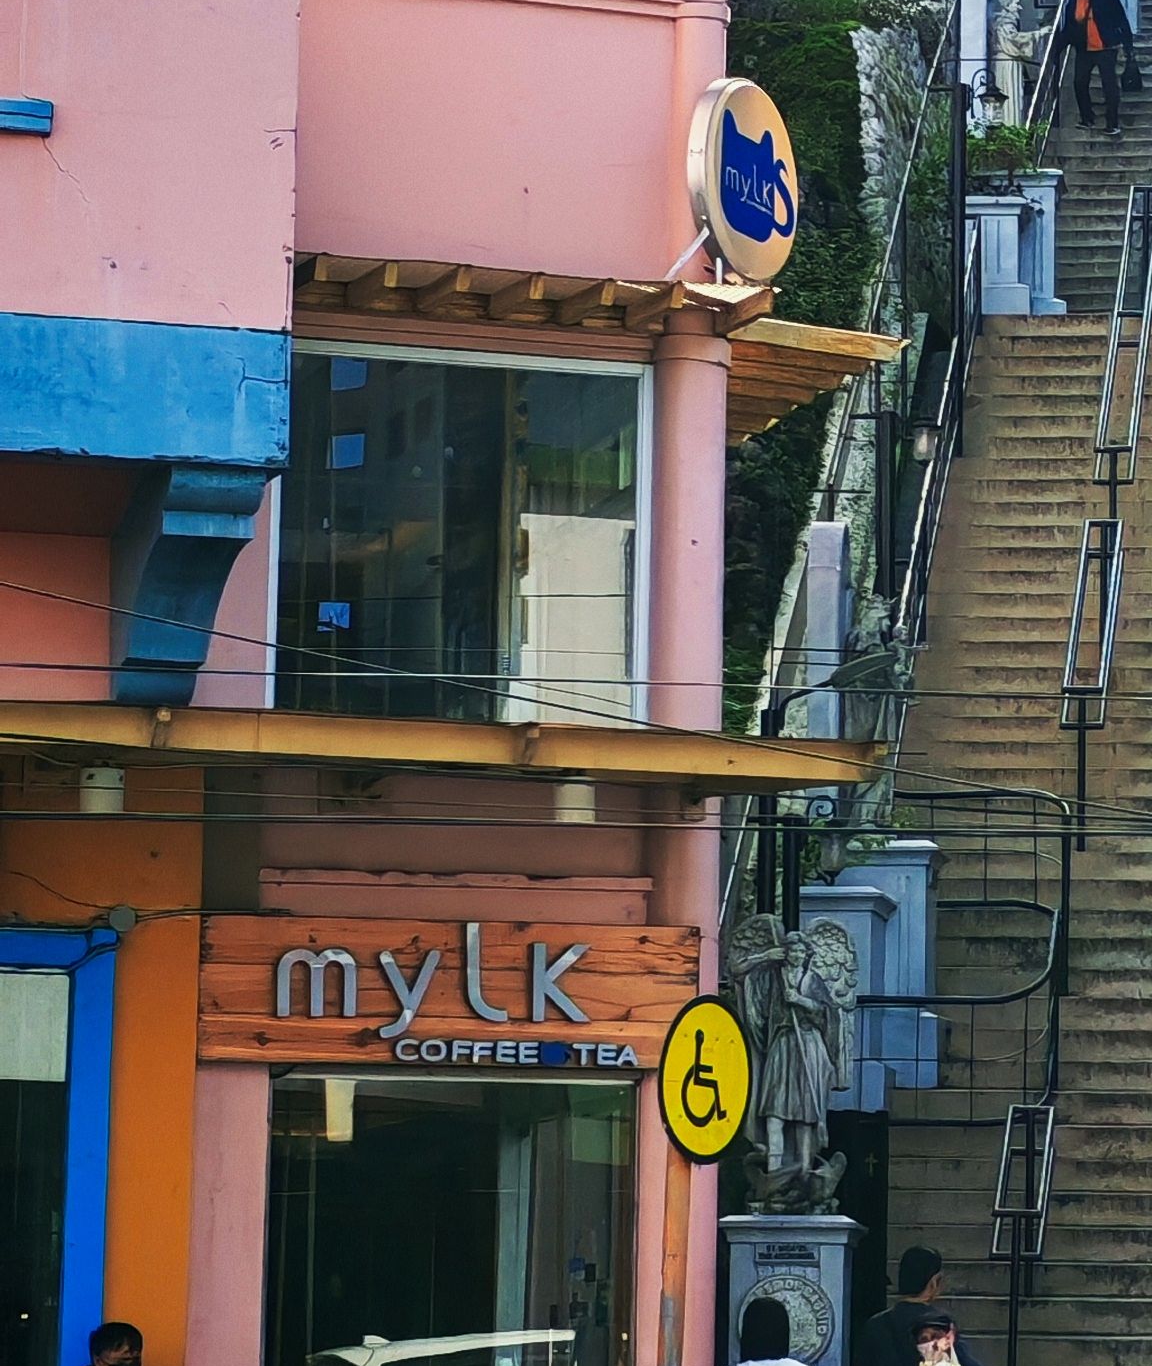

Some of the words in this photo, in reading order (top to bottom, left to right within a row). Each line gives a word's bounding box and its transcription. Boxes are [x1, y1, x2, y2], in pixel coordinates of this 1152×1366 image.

[725, 164, 773, 209] mylk
[275, 921, 593, 1039] mylk
[394, 1039, 540, 1065] COFFEE
[571, 1042, 639, 1067] TEA
